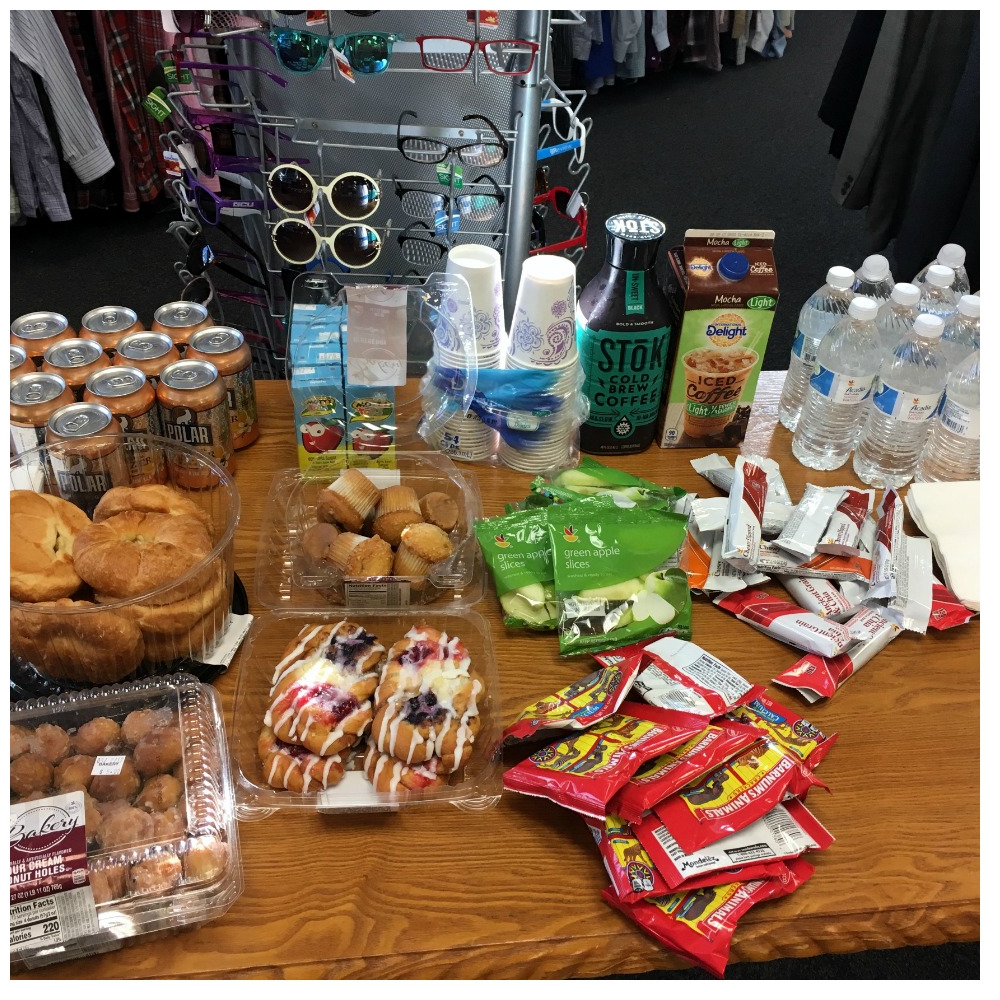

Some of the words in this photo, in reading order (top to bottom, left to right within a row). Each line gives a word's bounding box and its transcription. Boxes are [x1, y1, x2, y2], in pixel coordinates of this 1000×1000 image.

[145, 98, 166, 118] SIGHT
[707, 238, 730, 246] Mocha
[732, 239, 751, 247] Light
[690, 262, 714, 273] Delight
[749, 265, 774, 274] Coffee
[627, 304, 643, 312] BLACK
[714, 294, 742, 304] Mocha
[749, 296, 774, 310] Light
[706, 325, 748, 340] Delight
[609, 374, 651, 385] COLD
[697, 376, 738, 387] ICED
[609, 383, 649, 394] BREW
[686, 383, 743, 405] Coffee
[594, 387, 658, 407] COFFEE
[687, 403, 710, 416] Light
[167, 423, 210, 444] POLAR
[59, 471, 106, 493] POLAR
[497, 551, 525, 562] green
[564, 549, 592, 559] green
[593, 546, 621, 559] apple
[500, 561, 526, 571] slices
[565, 559, 590, 569] slices
[812, 591, 832, 616] Ancient
[823, 591, 837, 607] Chia
[796, 619, 822, 635] Grain
[748, 758, 793, 798] BARNUM'S
[704, 791, 752, 818] ANIMALS
[10, 813, 80, 841] Bakery
[28, 855, 63, 870] CREAM
[35, 864, 67, 879] HOLES
[33, 898, 54, 909] Facts
[42, 921, 60, 934] 220
